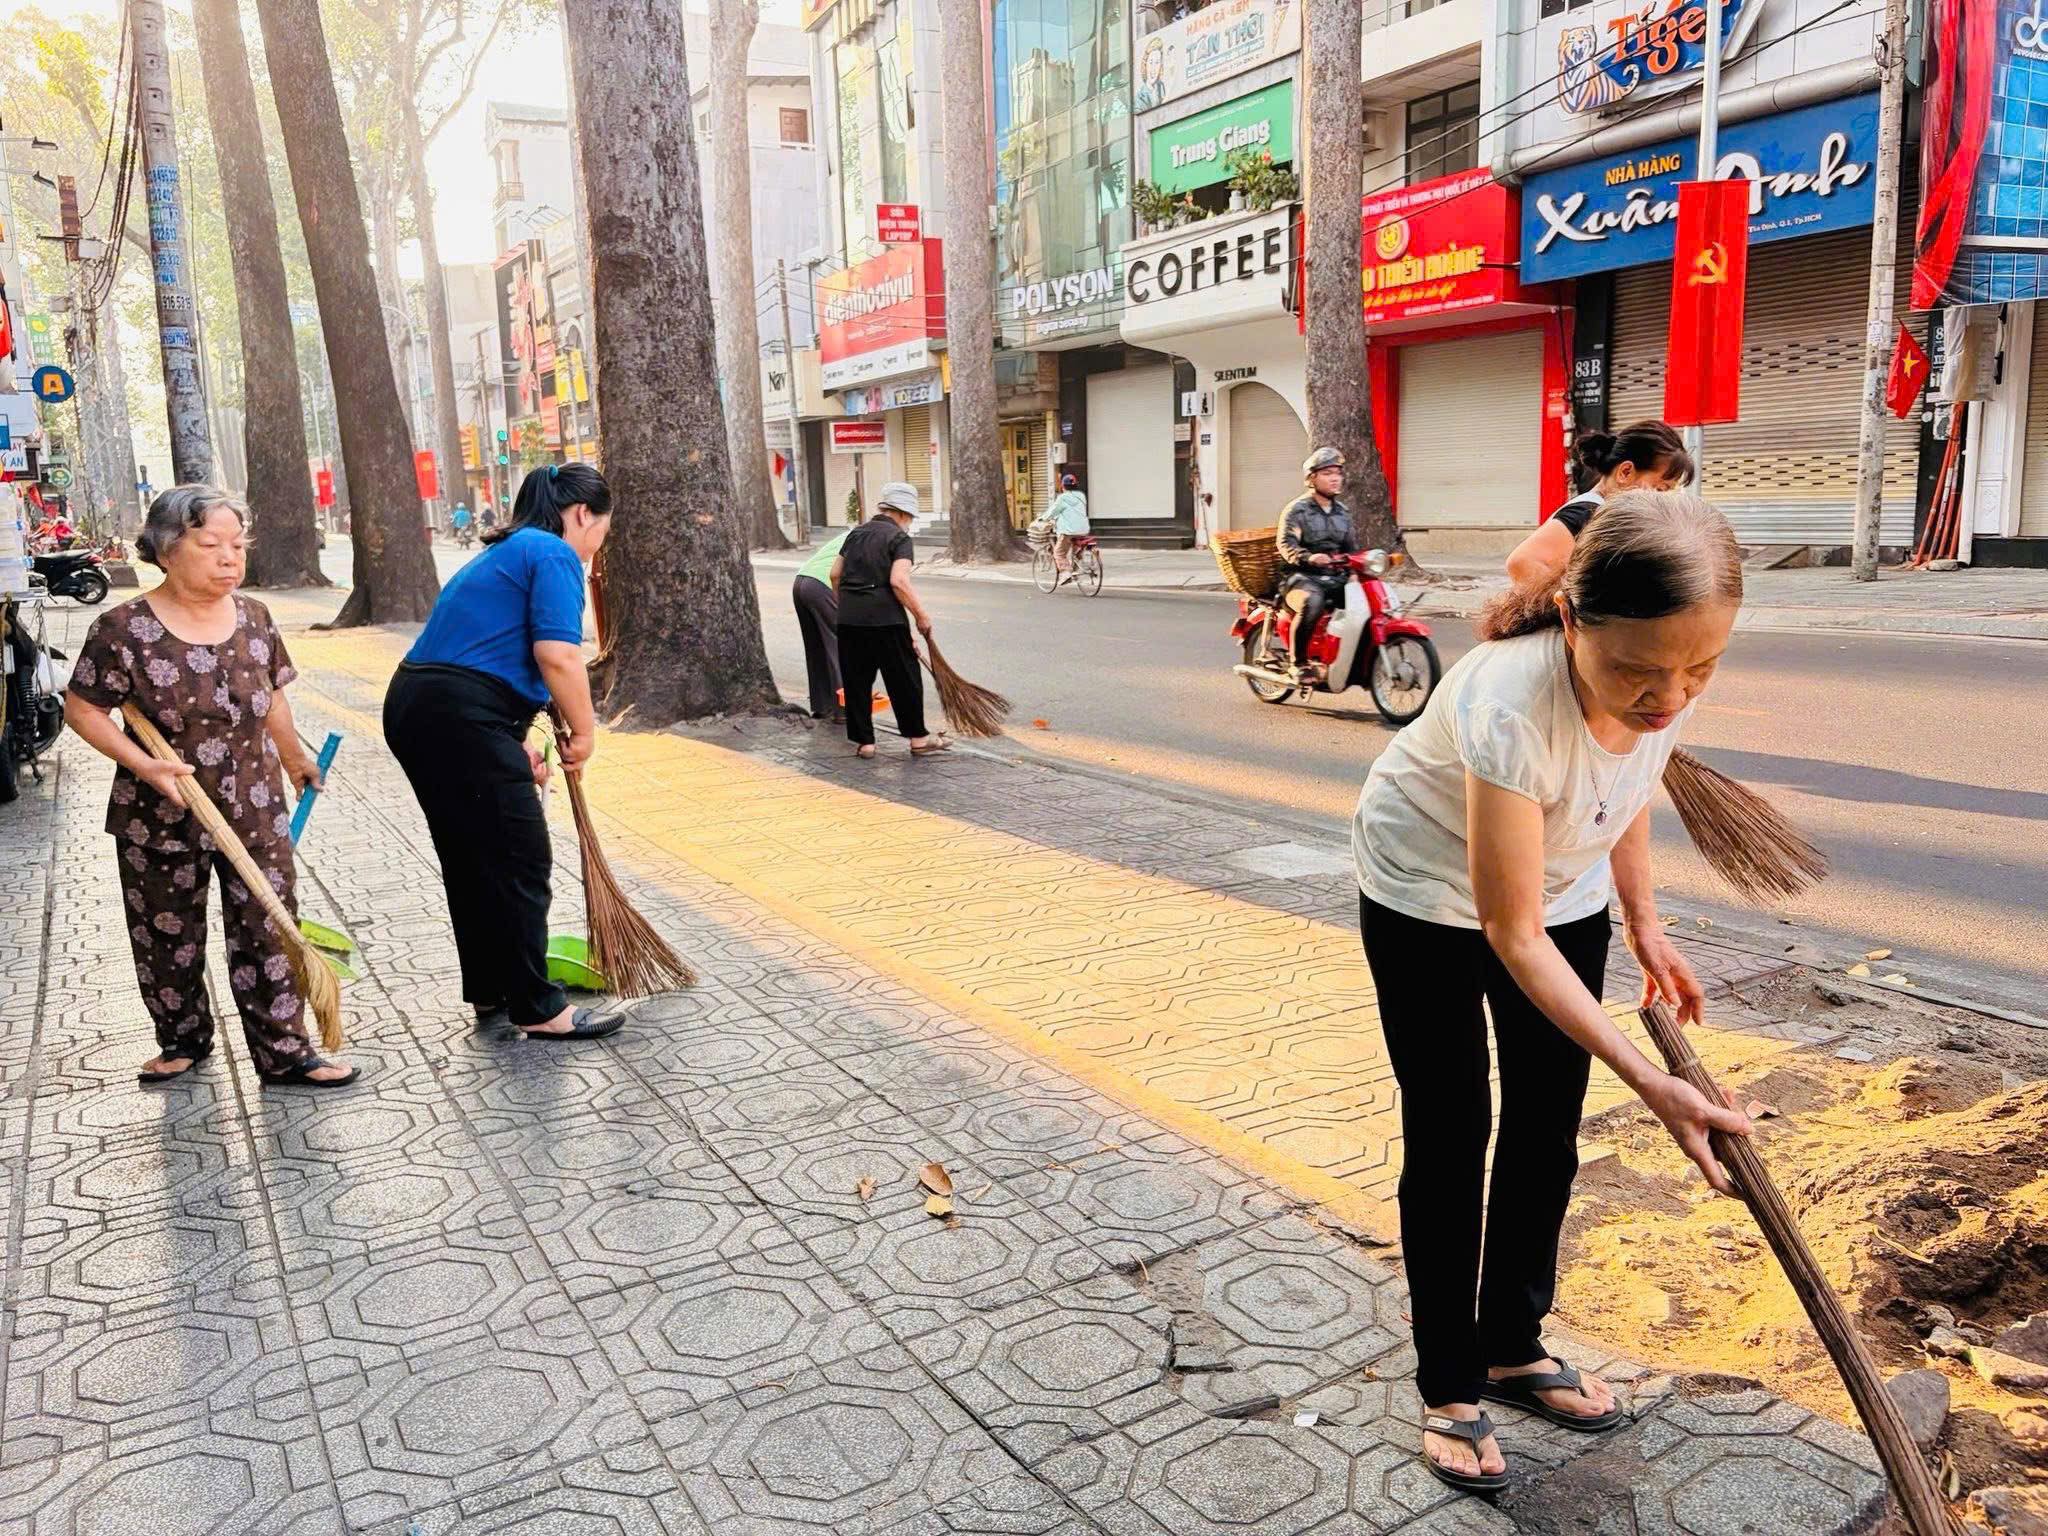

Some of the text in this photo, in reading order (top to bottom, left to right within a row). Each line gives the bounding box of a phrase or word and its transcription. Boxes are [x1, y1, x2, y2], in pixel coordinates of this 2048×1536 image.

[1607, 0, 1730, 75] Tige
[1169, 118, 1271, 169] Trung Giang
[1535, 132, 1868, 254] Xuân Anh
[1605, 153, 1682, 187] NHÀ HÀNG
[1127, 226, 1281, 303] COFFEE
[1012, 266, 1114, 320] POLYSON
[43, 373, 65, 396] A
[1575, 358, 1601, 377] 83B
